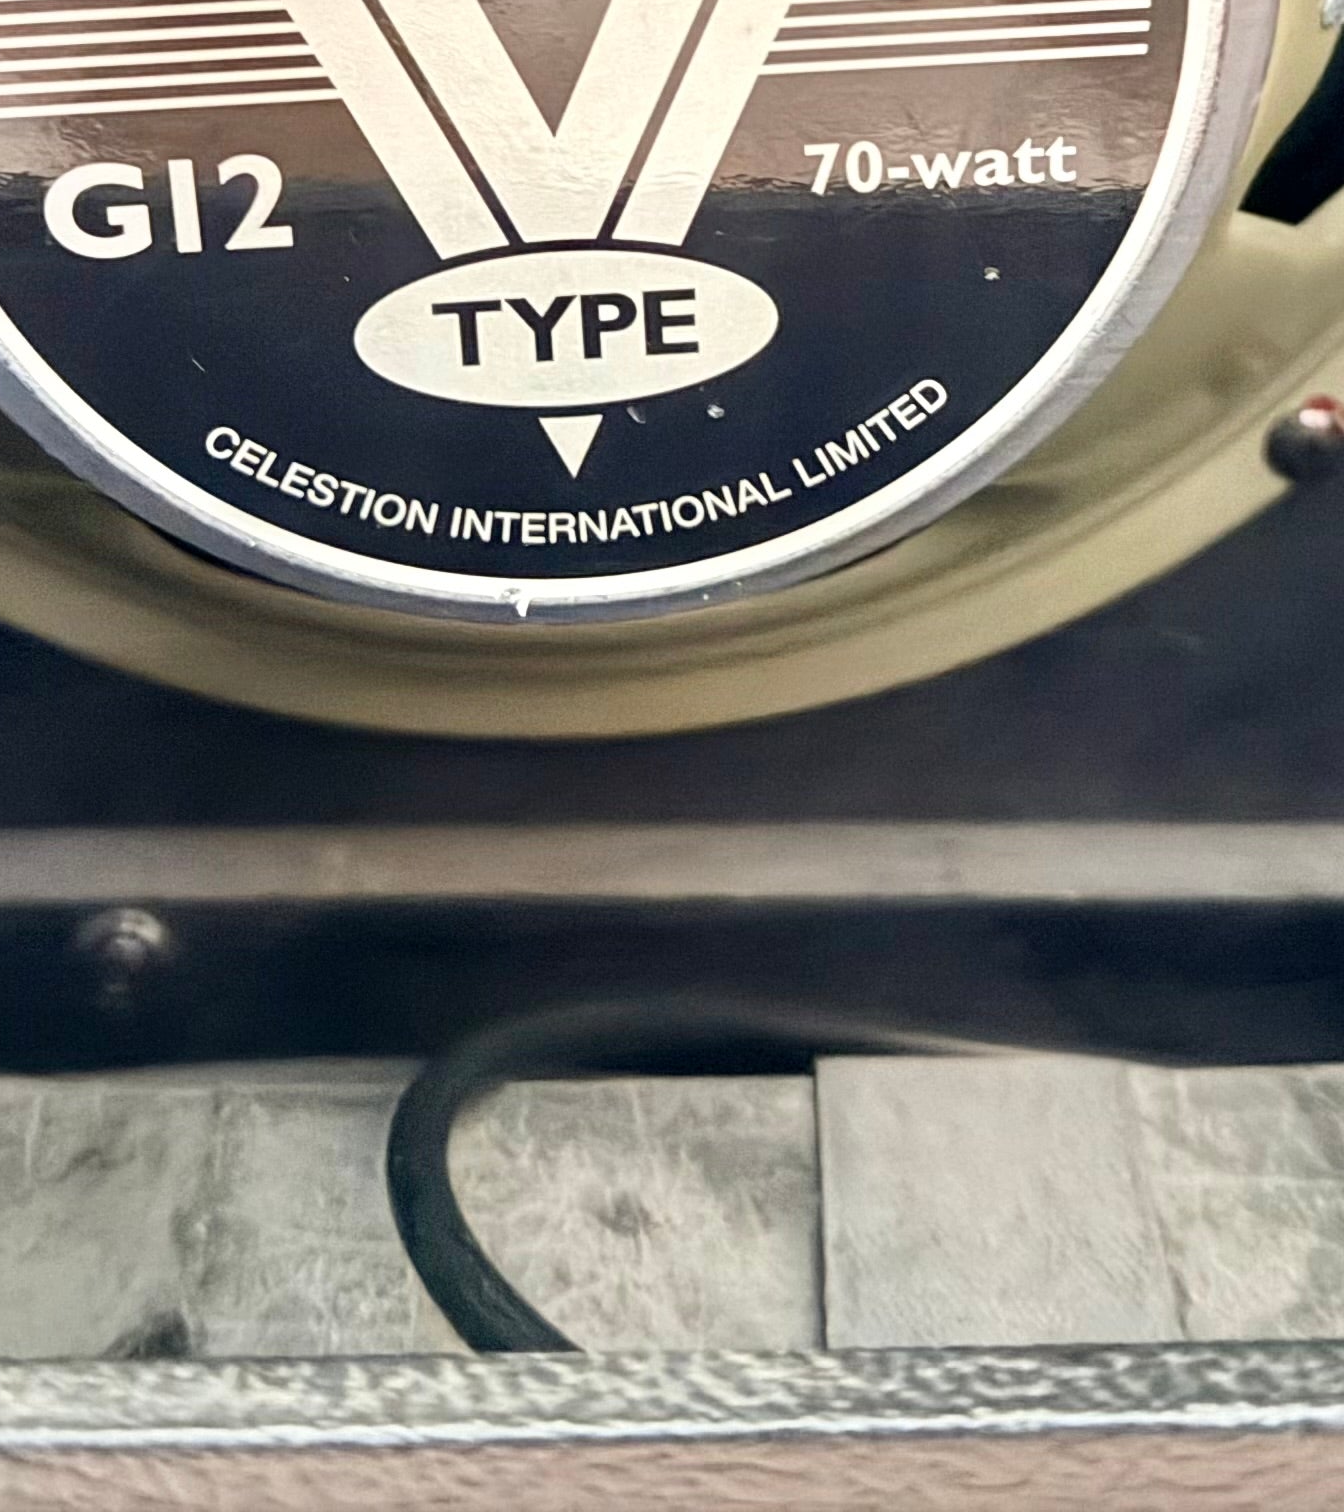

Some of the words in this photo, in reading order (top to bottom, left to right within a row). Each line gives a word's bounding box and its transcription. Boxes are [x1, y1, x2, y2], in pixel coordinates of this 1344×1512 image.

[802, 135, 1079, 196] 70-watt
[431, 288, 700, 367] TYPE
[204, 425, 440, 535] CELESTION
[449, 471, 794, 545] INTERNATIONAL
[791, 378, 949, 489] LIMITED
